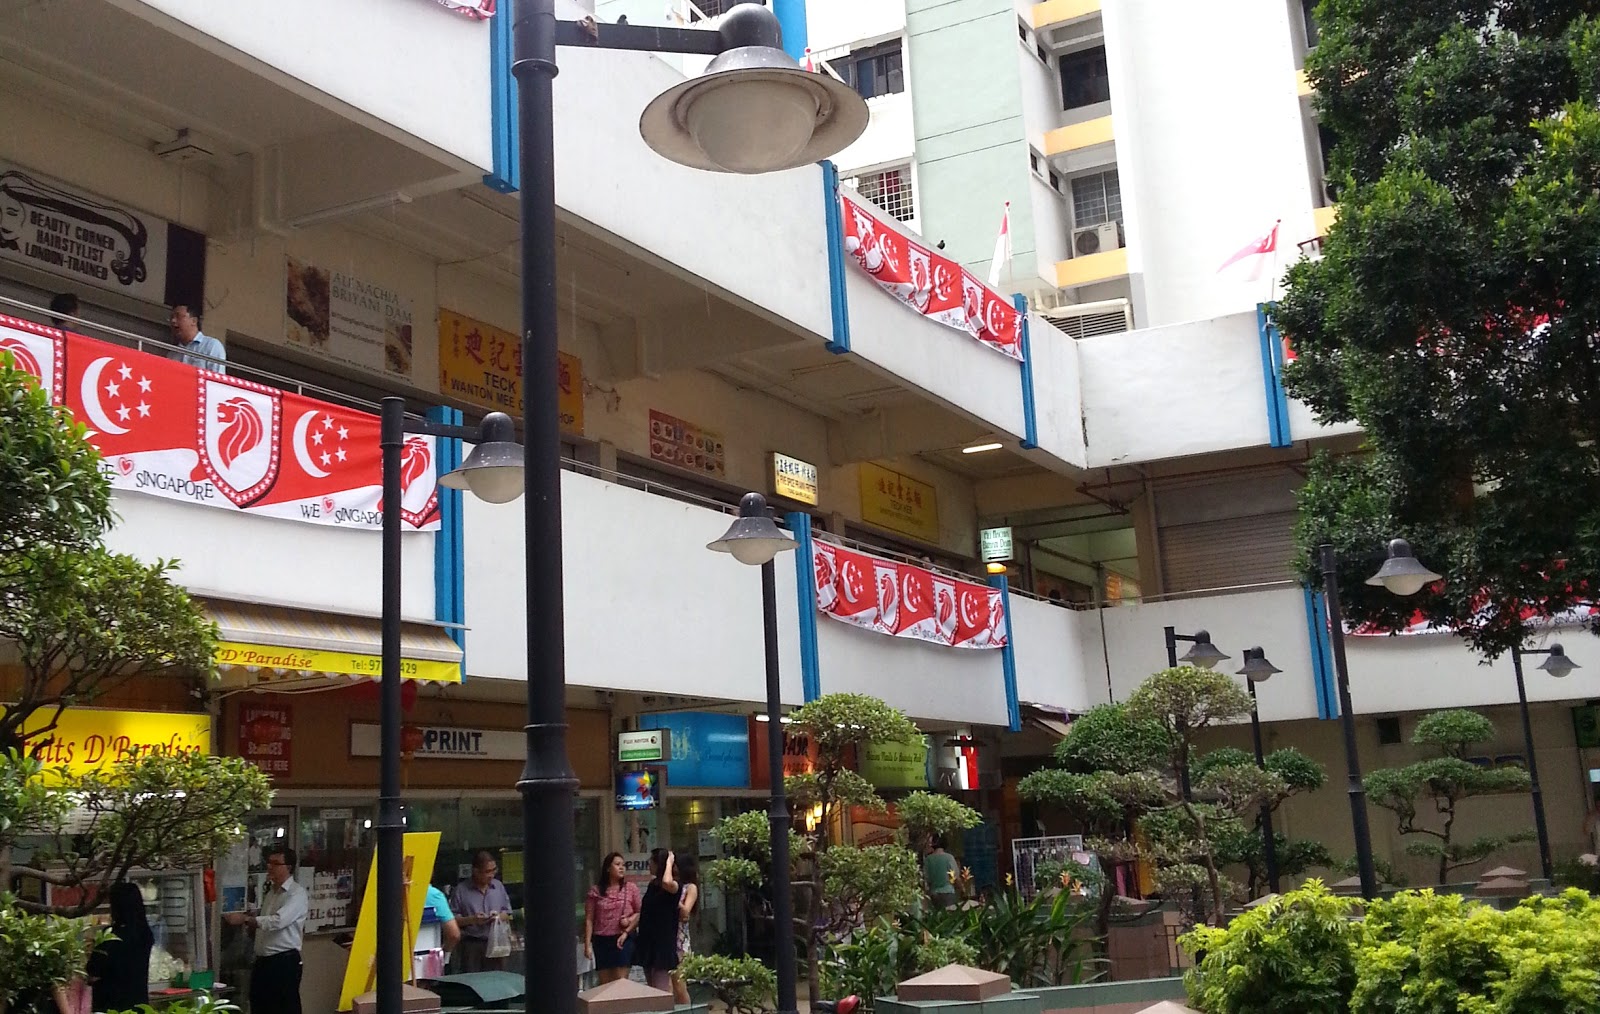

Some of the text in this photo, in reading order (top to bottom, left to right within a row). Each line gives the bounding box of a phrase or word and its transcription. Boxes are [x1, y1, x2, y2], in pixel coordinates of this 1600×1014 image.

[30, 210, 115, 251] BEAUTY CORNER
[36, 229, 104, 263] HAIRSTYLIST
[25, 242, 108, 280] LONDON-TRAINED
[385, 304, 412, 324] DAM
[451, 377, 493, 401] WANTON
[496, 392, 515, 409] MEE
[484, 371, 517, 395] TECK
[135, 469, 214, 501] SINGAPORE
[300, 503, 320, 519] WE
[221, 649, 313, 668] D'Paradise
[352, 660, 367, 670] Tel:
